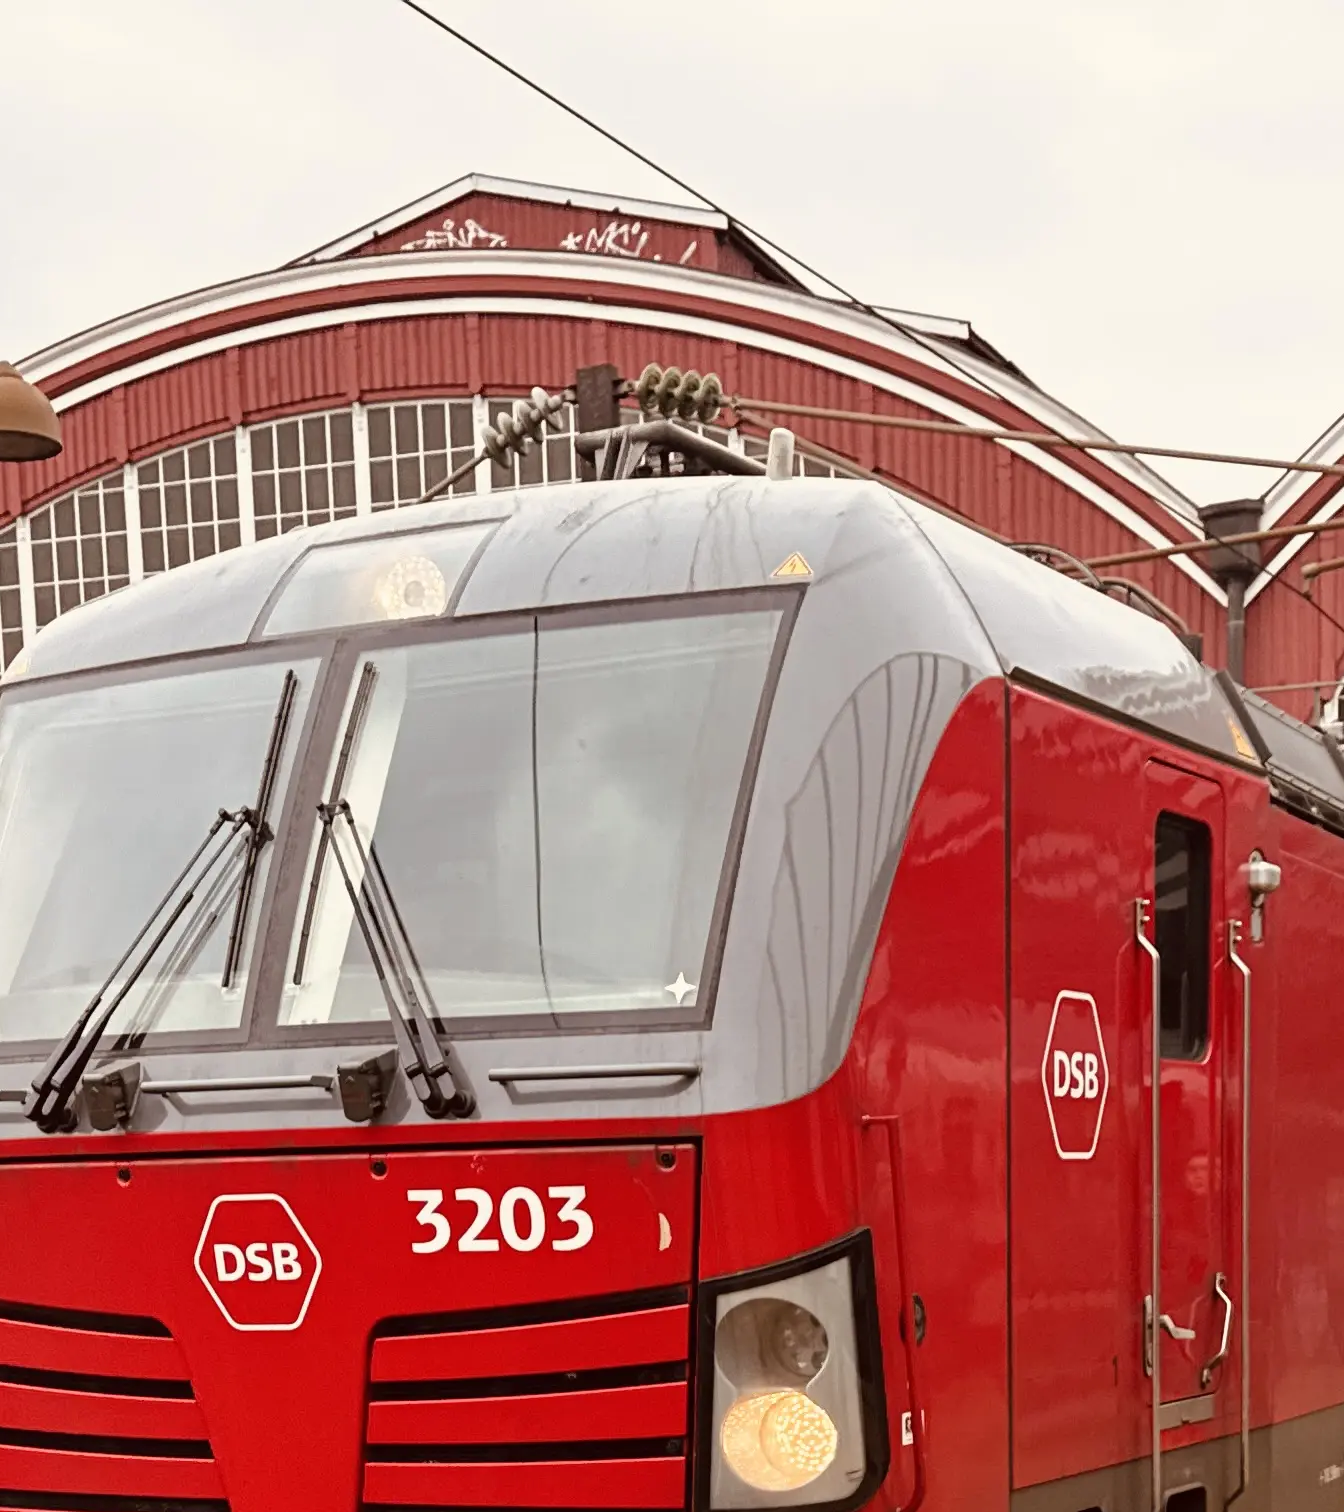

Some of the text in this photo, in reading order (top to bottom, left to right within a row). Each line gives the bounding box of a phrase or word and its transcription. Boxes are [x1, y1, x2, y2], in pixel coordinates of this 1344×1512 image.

[1053, 1050, 1099, 1099] DSB
[407, 1186, 594, 1254] 3203
[213, 1242, 302, 1282] DSB
